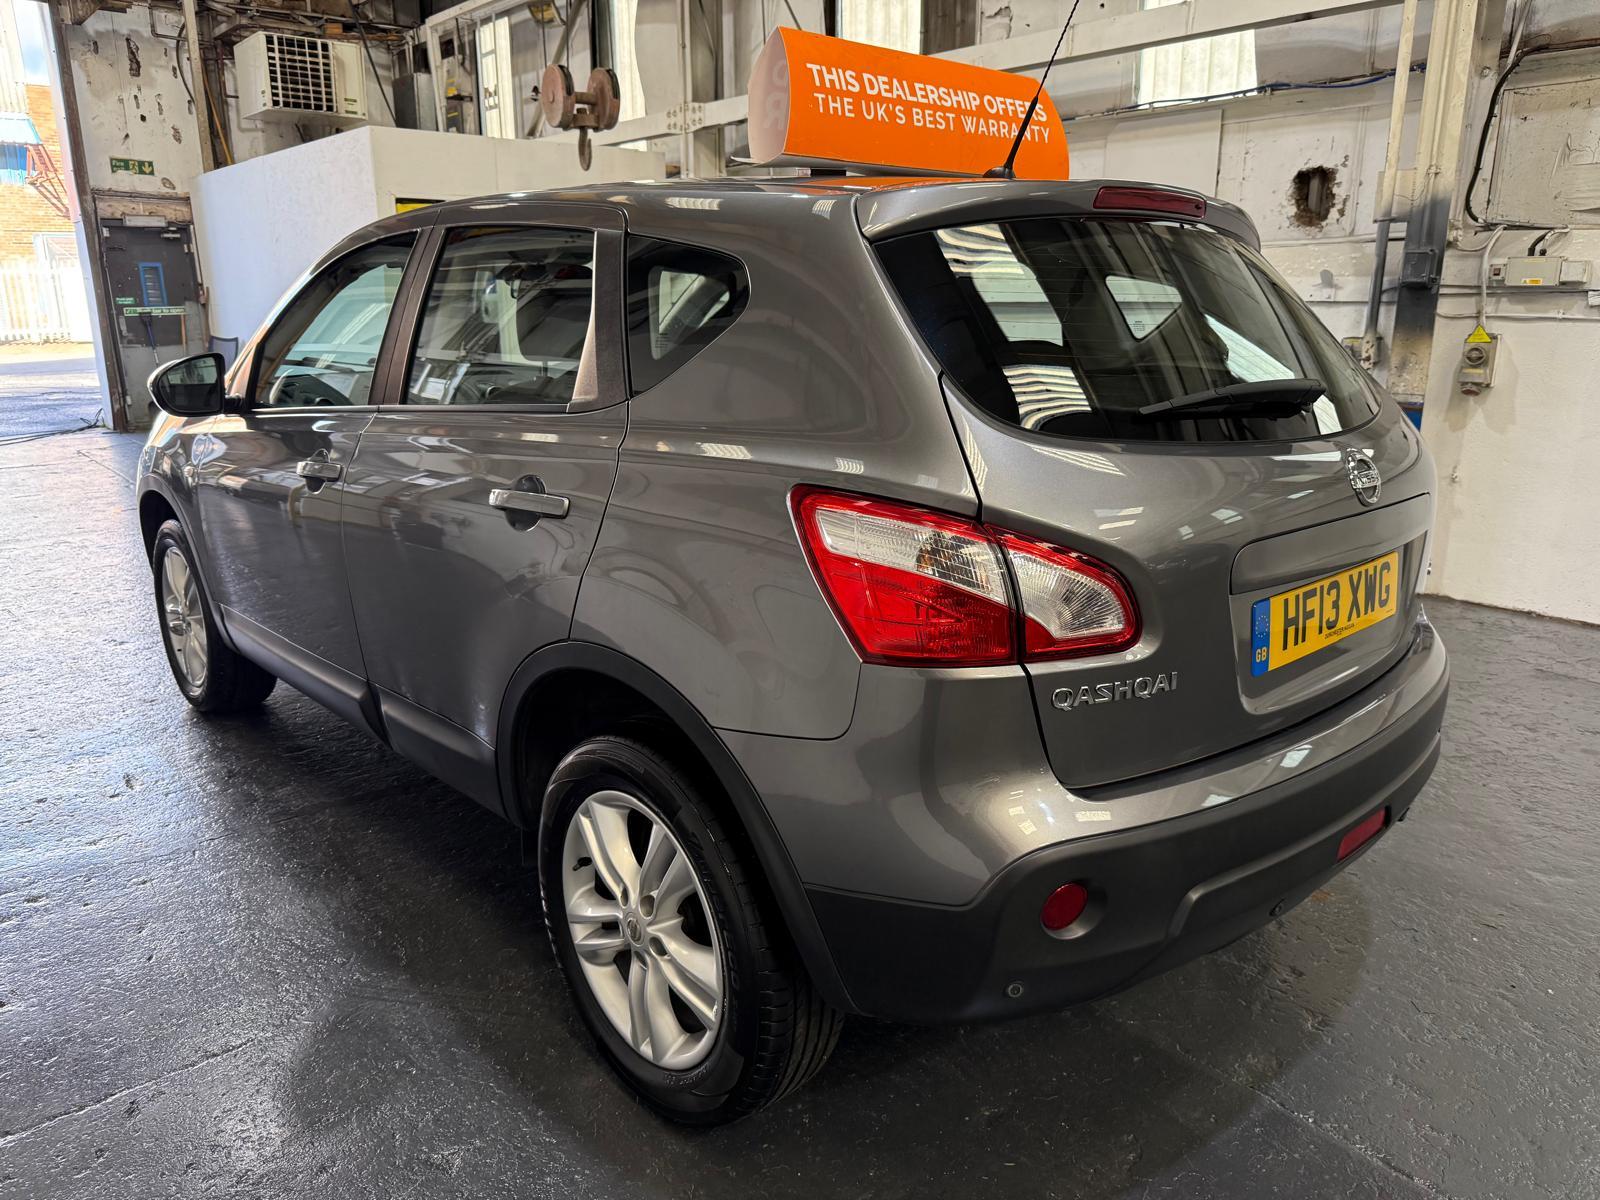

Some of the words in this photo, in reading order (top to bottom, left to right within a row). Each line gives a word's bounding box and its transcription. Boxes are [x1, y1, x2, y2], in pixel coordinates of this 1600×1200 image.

[806, 63, 860, 93] THIS
[862, 72, 980, 110] DEALERSHIP
[813, 92, 855, 118] THE
[861, 101, 906, 125] UK'S
[912, 107, 955, 131] BEST
[1282, 579, 1341, 651] HF13
[1347, 560, 1391, 622] XWG
[1255, 646, 1268, 664] GB
[1051, 671, 1178, 711] QASHQAI
